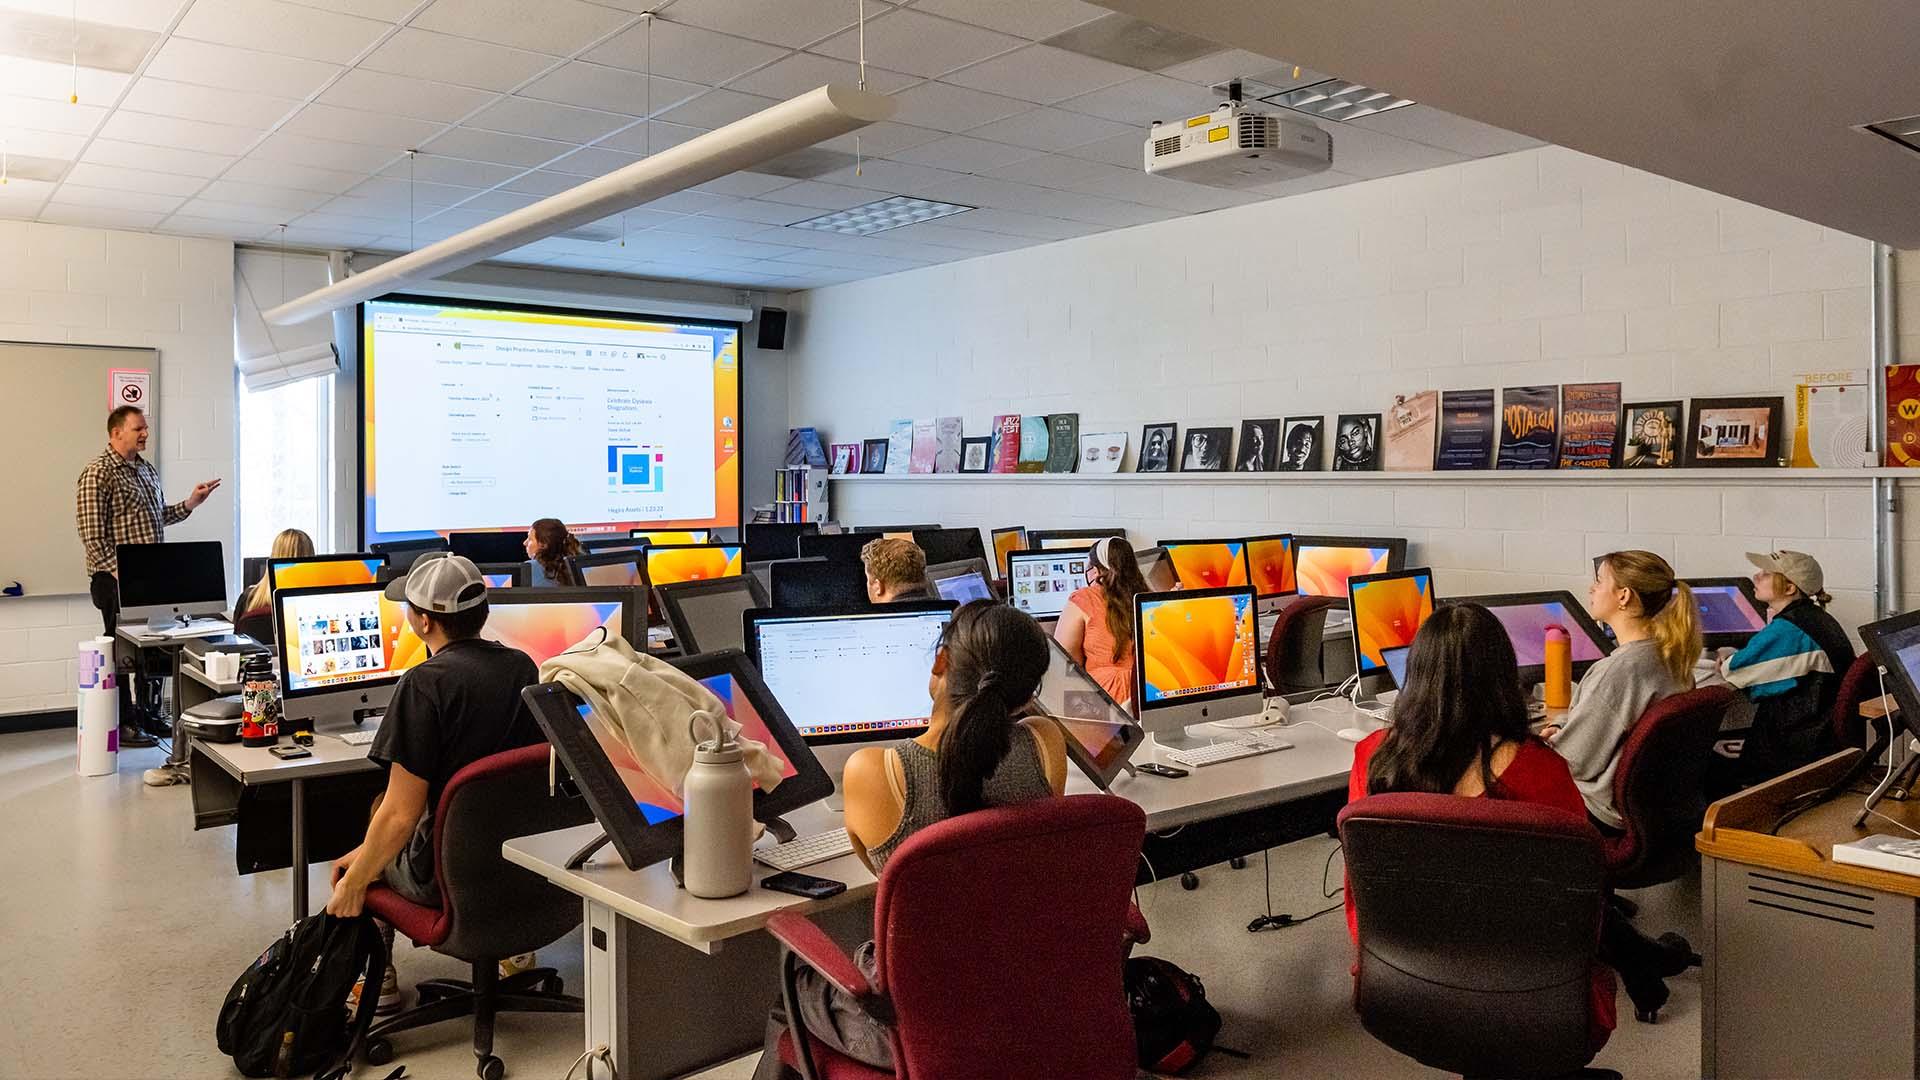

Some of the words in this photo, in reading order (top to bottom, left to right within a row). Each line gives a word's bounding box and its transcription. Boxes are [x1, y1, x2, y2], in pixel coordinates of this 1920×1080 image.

[1805, 372, 1852, 384] BEFORE
[1902, 405, 1918, 415] W
[1003, 416, 1020, 425] JAZZ
[1504, 405, 1555, 440] NOSTALGIA
[1564, 411, 1617, 427] NOSTALGIA
[1002, 425, 1020, 433] FEST
[1560, 459, 1573, 468] THE
